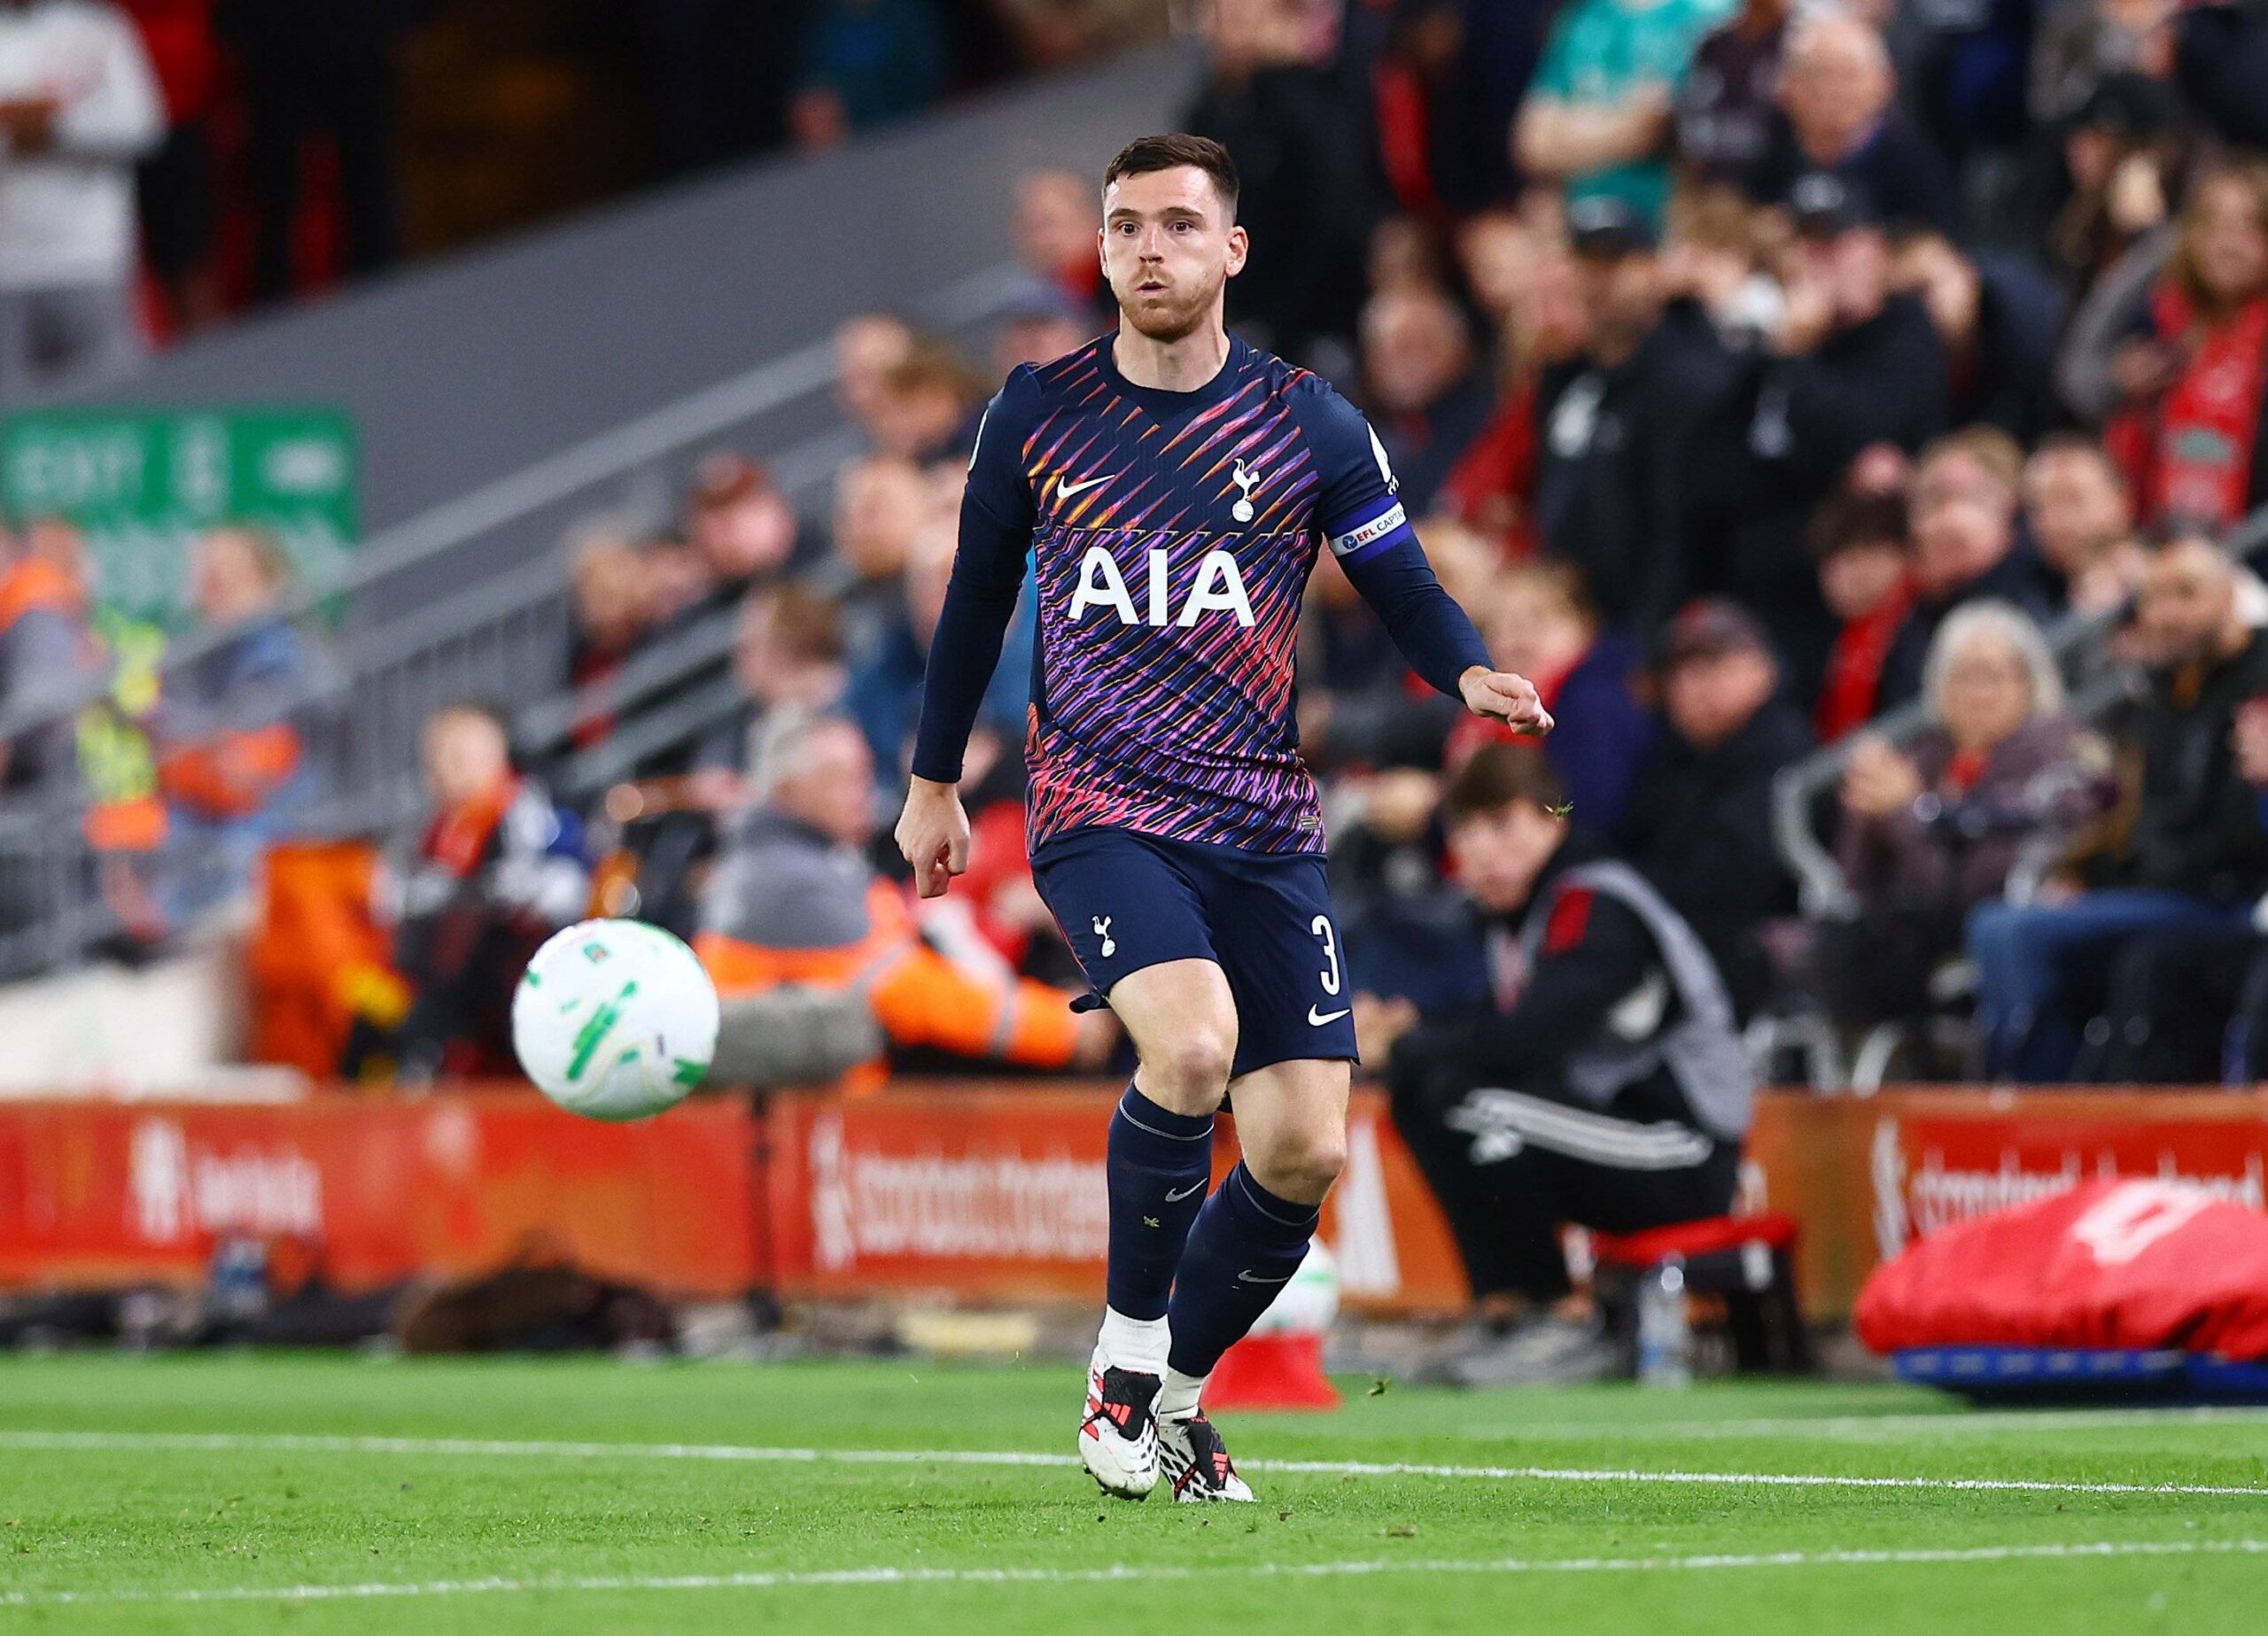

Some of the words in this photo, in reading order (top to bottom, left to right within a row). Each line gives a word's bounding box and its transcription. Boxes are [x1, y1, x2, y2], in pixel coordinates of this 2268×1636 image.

[1356, 529, 1376, 541] EFL
[1068, 547, 1255, 626] AIA
[1312, 915, 1340, 996] 3
